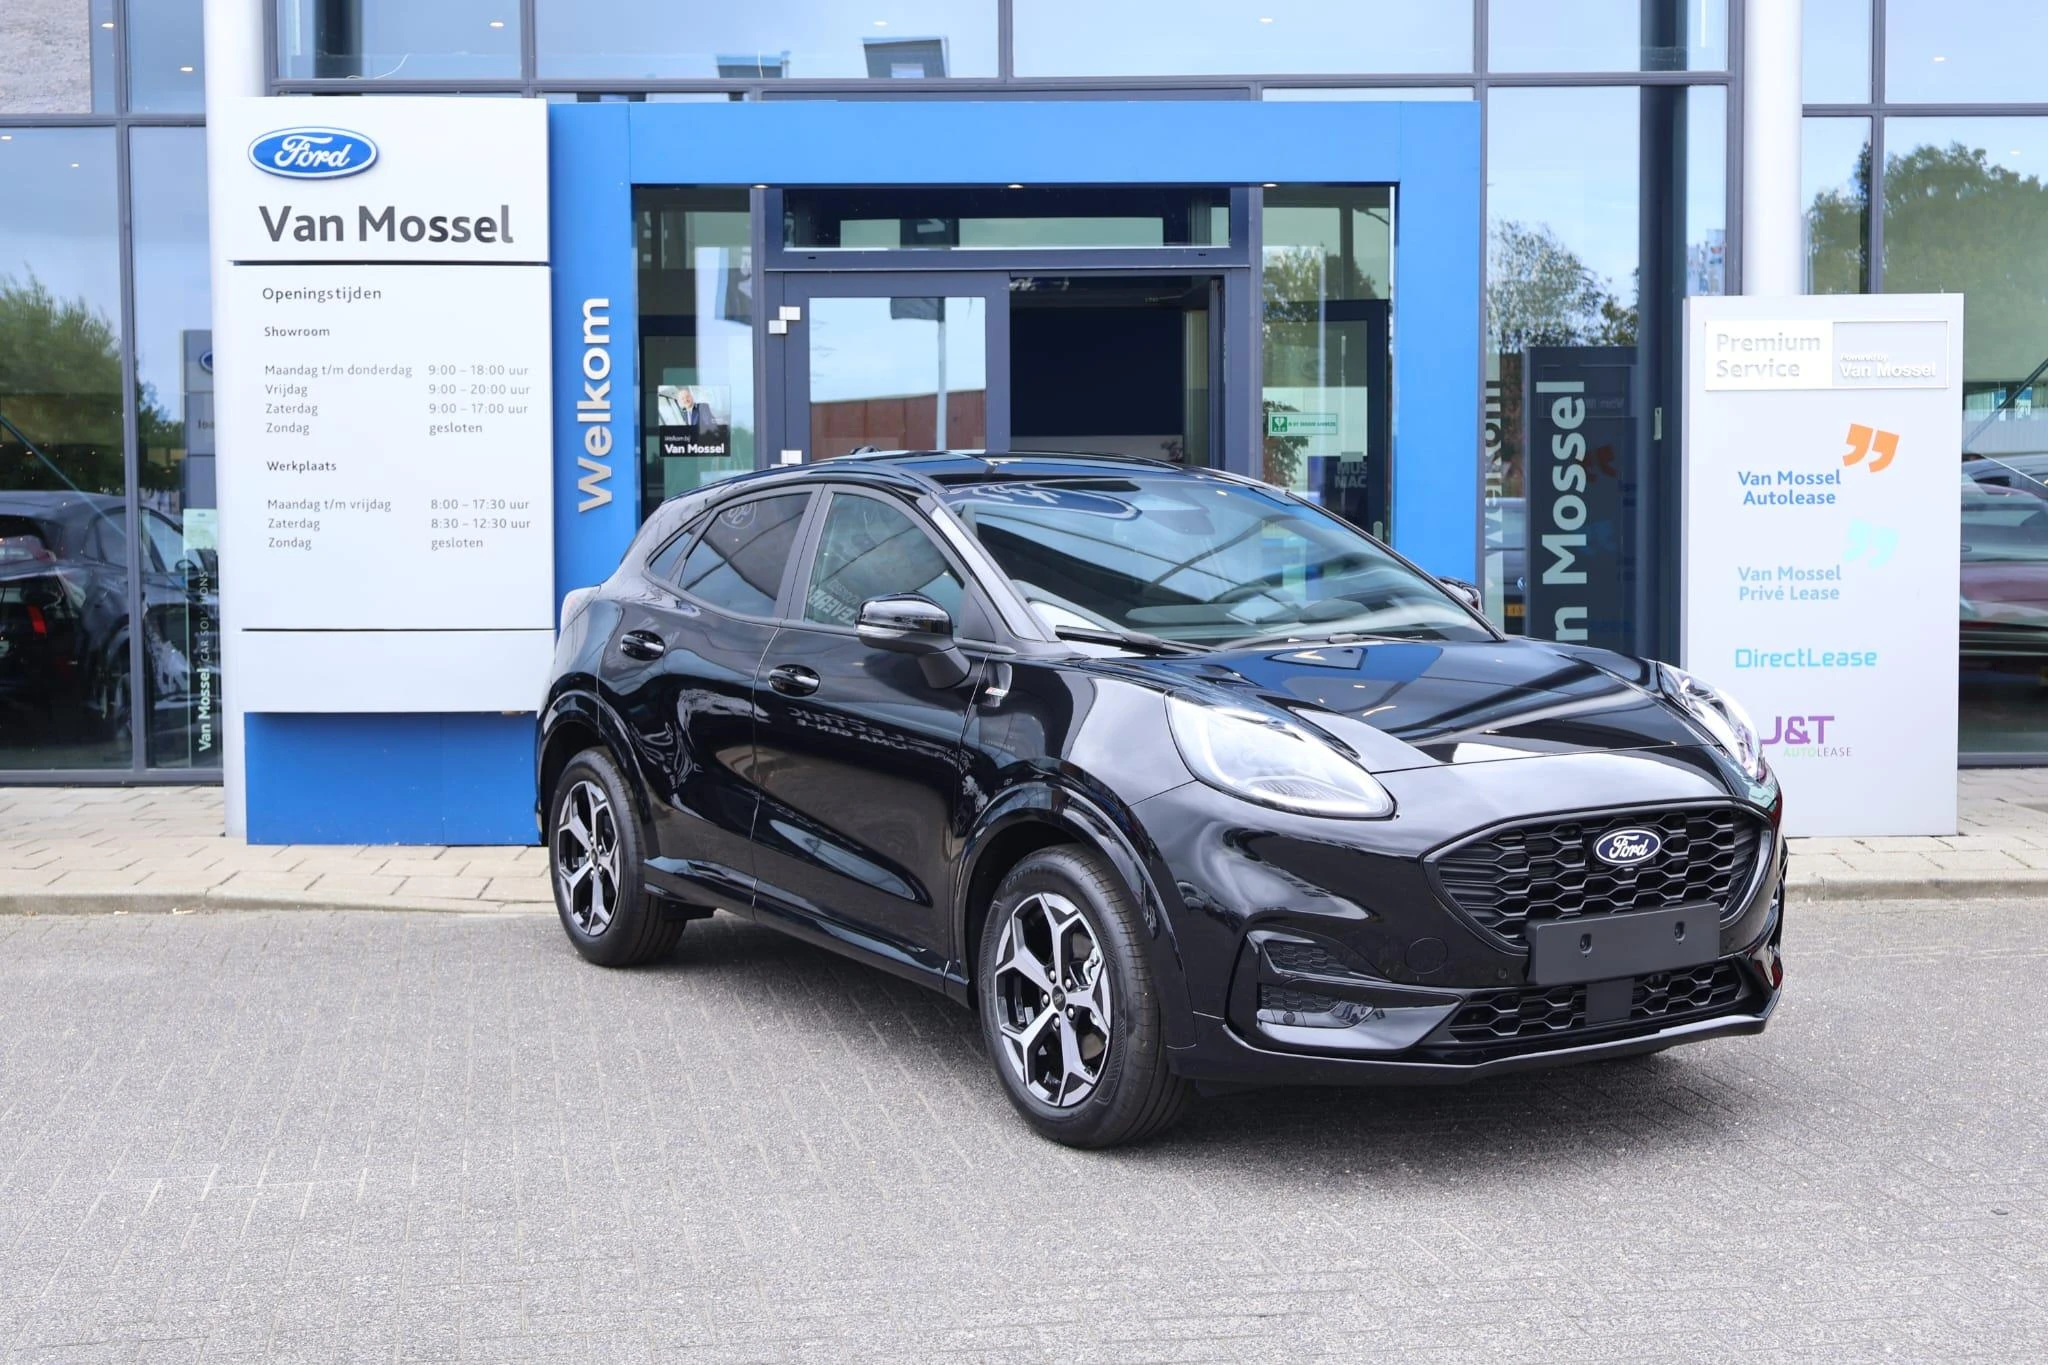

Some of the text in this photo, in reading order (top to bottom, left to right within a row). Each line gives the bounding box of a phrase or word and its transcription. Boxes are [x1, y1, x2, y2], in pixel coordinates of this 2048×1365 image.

[274, 135, 352, 167] Ford
[258, 204, 515, 243] Van Mossel
[262, 287, 382, 303] Openingstijden
[264, 326, 331, 337] Showroom
[1716, 332, 1821, 352] Premium
[265, 365, 318, 378] Maandag
[321, 365, 344, 375] t/m
[347, 364, 413, 378] donderdag
[428, 365, 456, 375] 9:00
[471, 365, 505, 375] 18:00
[508, 367, 529, 375] uur
[1716, 358, 1800, 378] Service
[1839, 361, 1937, 378] Van Mossel
[265, 384, 308, 397] Vrijdag
[428, 384, 457, 394] 9:00
[470, 384, 507, 395] 20:00
[510, 386, 531, 395] uur
[265, 403, 319, 416] Zaterdag
[429, 403, 457, 414] 9:00
[471, 403, 505, 414] 17:00
[508, 405, 529, 414] uur
[577, 298, 613, 513] Welkom
[265, 422, 483, 436] Zondag gesloten
[664, 443, 725, 454] Van Mossel
[267, 461, 337, 473] Werkplaats
[1536, 381, 1588, 585] Mossel
[1737, 469, 1842, 486] Van Mossel
[267, 499, 321, 512] Maandag
[324, 499, 346, 509] t/m
[350, 499, 392, 512] vrijdag
[431, 499, 459, 510] 8:00
[472, 499, 506, 510] 17:30
[509, 501, 530, 510] uur
[1743, 489, 1836, 505] Autolease
[268, 518, 320, 531] Zaterdag
[431, 518, 459, 529] 8:30
[472, 518, 507, 529] 12:30
[511, 520, 531, 529] uur
[268, 537, 484, 551] Zondag gesloten
[1737, 564, 1842, 582] Van Mossel
[1739, 585, 1840, 601] Privé Lease
[200, 640, 210, 662] CAR
[1735, 648, 1878, 669] DirectLease
[197, 667, 212, 720] Mossel
[199, 723, 212, 752] Van
[1760, 715, 1835, 745] J&T
[1784, 747, 1853, 757] AUTOLEASE
[1609, 835, 1649, 858] Ford
